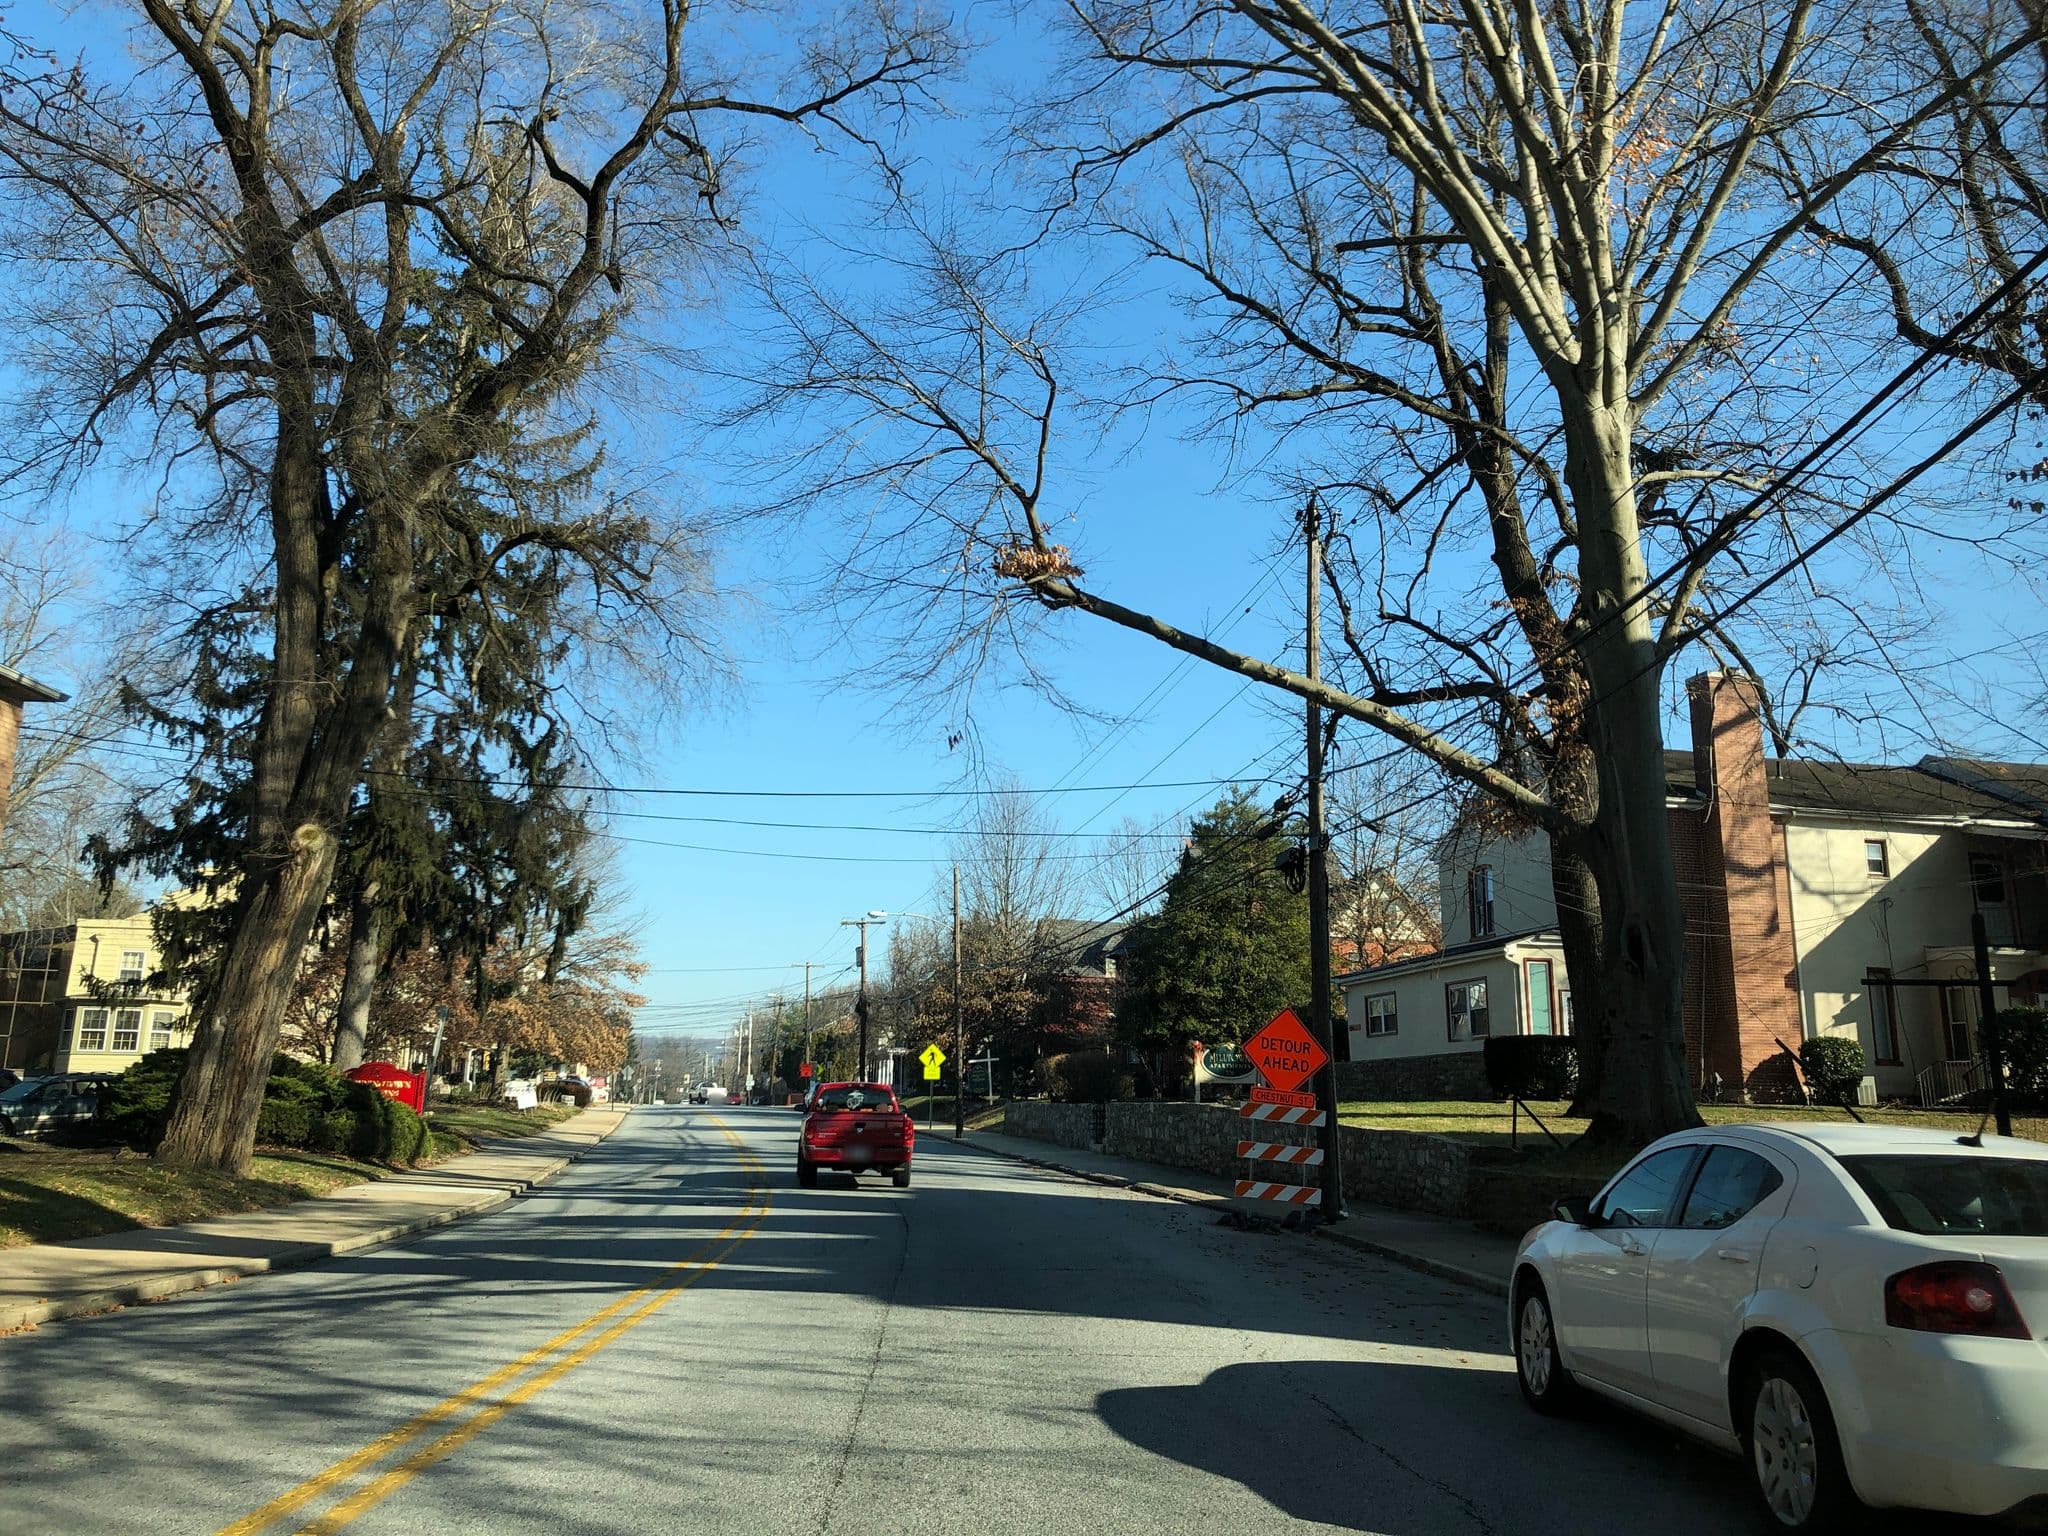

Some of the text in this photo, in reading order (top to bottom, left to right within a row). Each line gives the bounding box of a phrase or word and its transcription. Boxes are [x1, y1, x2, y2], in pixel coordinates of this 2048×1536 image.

[1261, 1037, 1310, 1055] DETOUR
[1263, 1056, 1309, 1073] AHEAD
[1256, 1091, 1294, 1104] CHESTNUT
